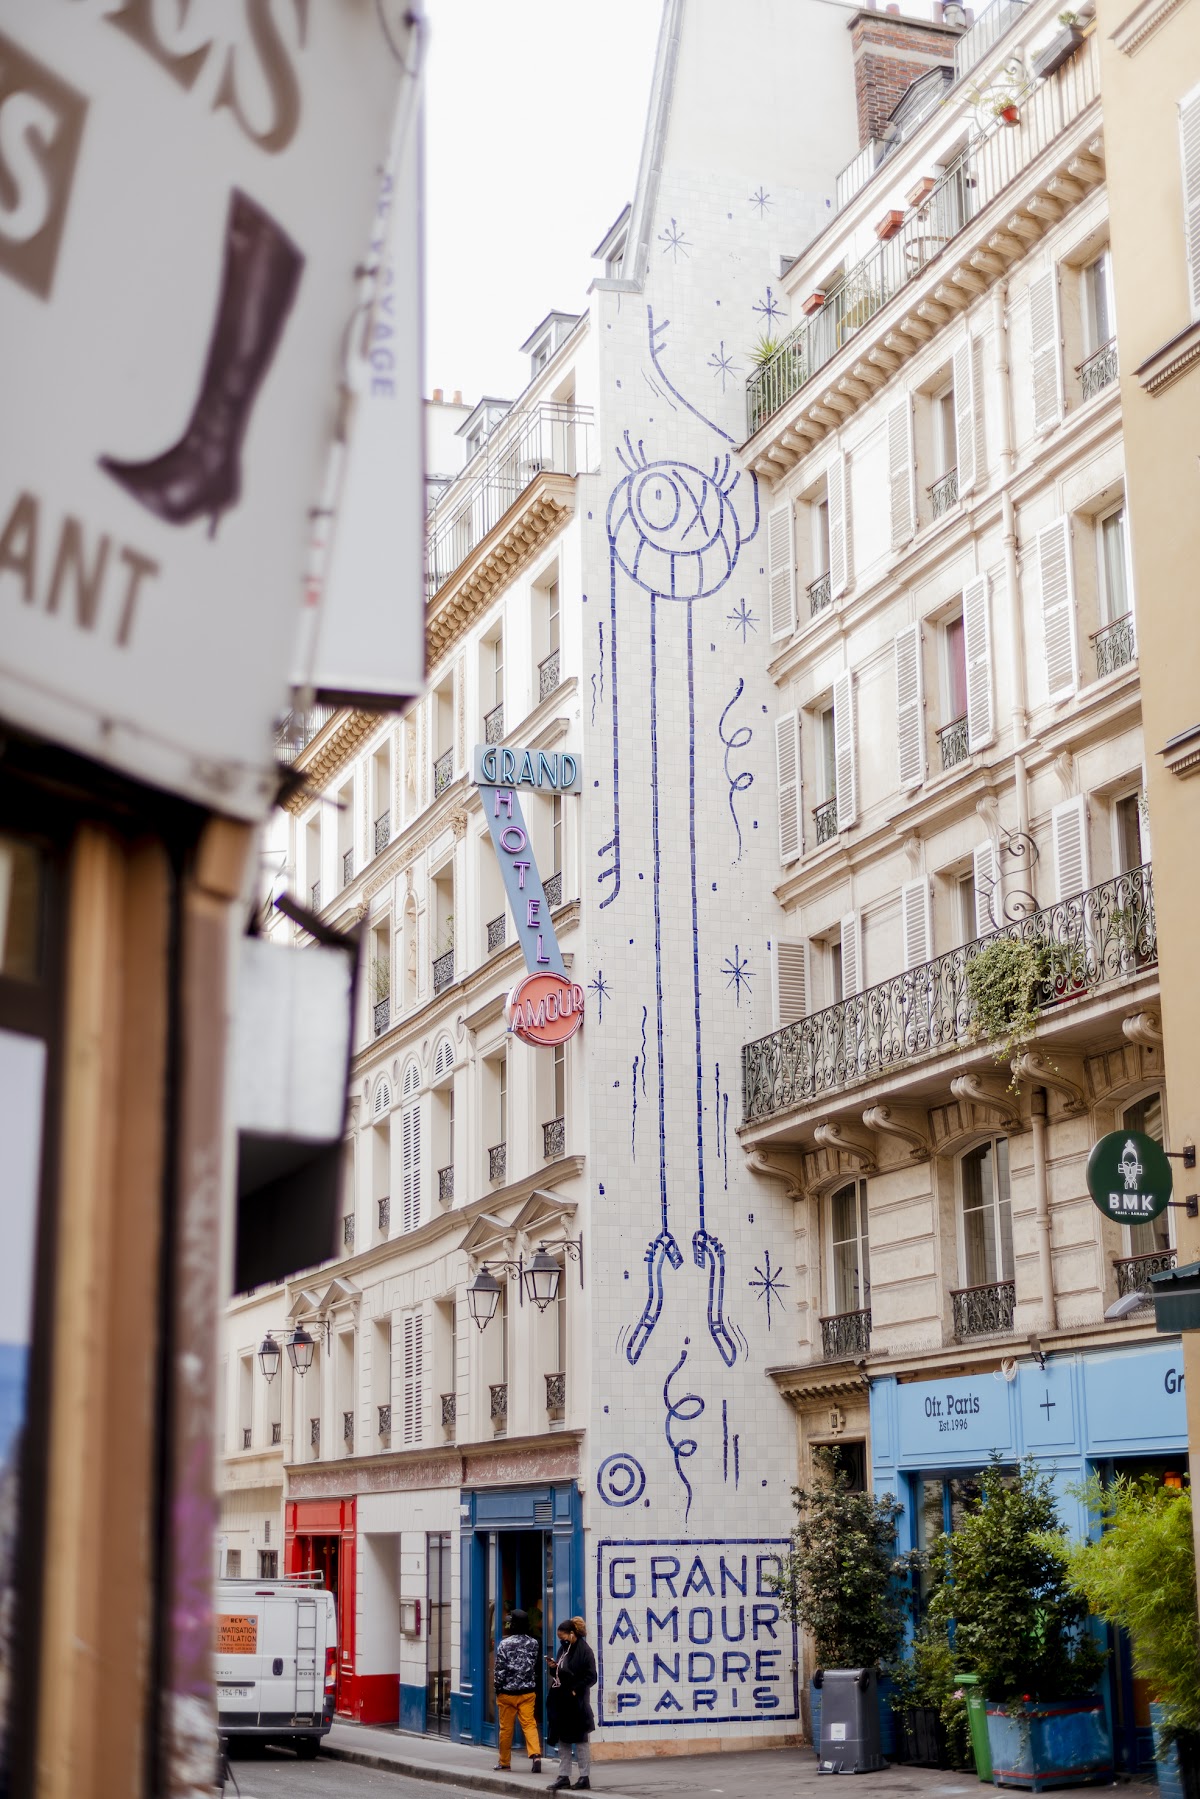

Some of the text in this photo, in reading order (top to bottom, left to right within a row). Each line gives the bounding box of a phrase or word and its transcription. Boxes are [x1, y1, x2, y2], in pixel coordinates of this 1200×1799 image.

[481, 748, 577, 789] GRAND
[495, 789, 549, 963] HOTEL
[511, 984, 585, 1032] AMOUR
[1109, 1193, 1153, 1211] BMK
[946, 1393, 980, 1415] Paris
[609, 1554, 784, 1599] GRAND
[608, 1603, 781, 1646] AMOUR
[616, 1649, 782, 1686] ANDRE
[617, 1686, 780, 1713] PARIS
